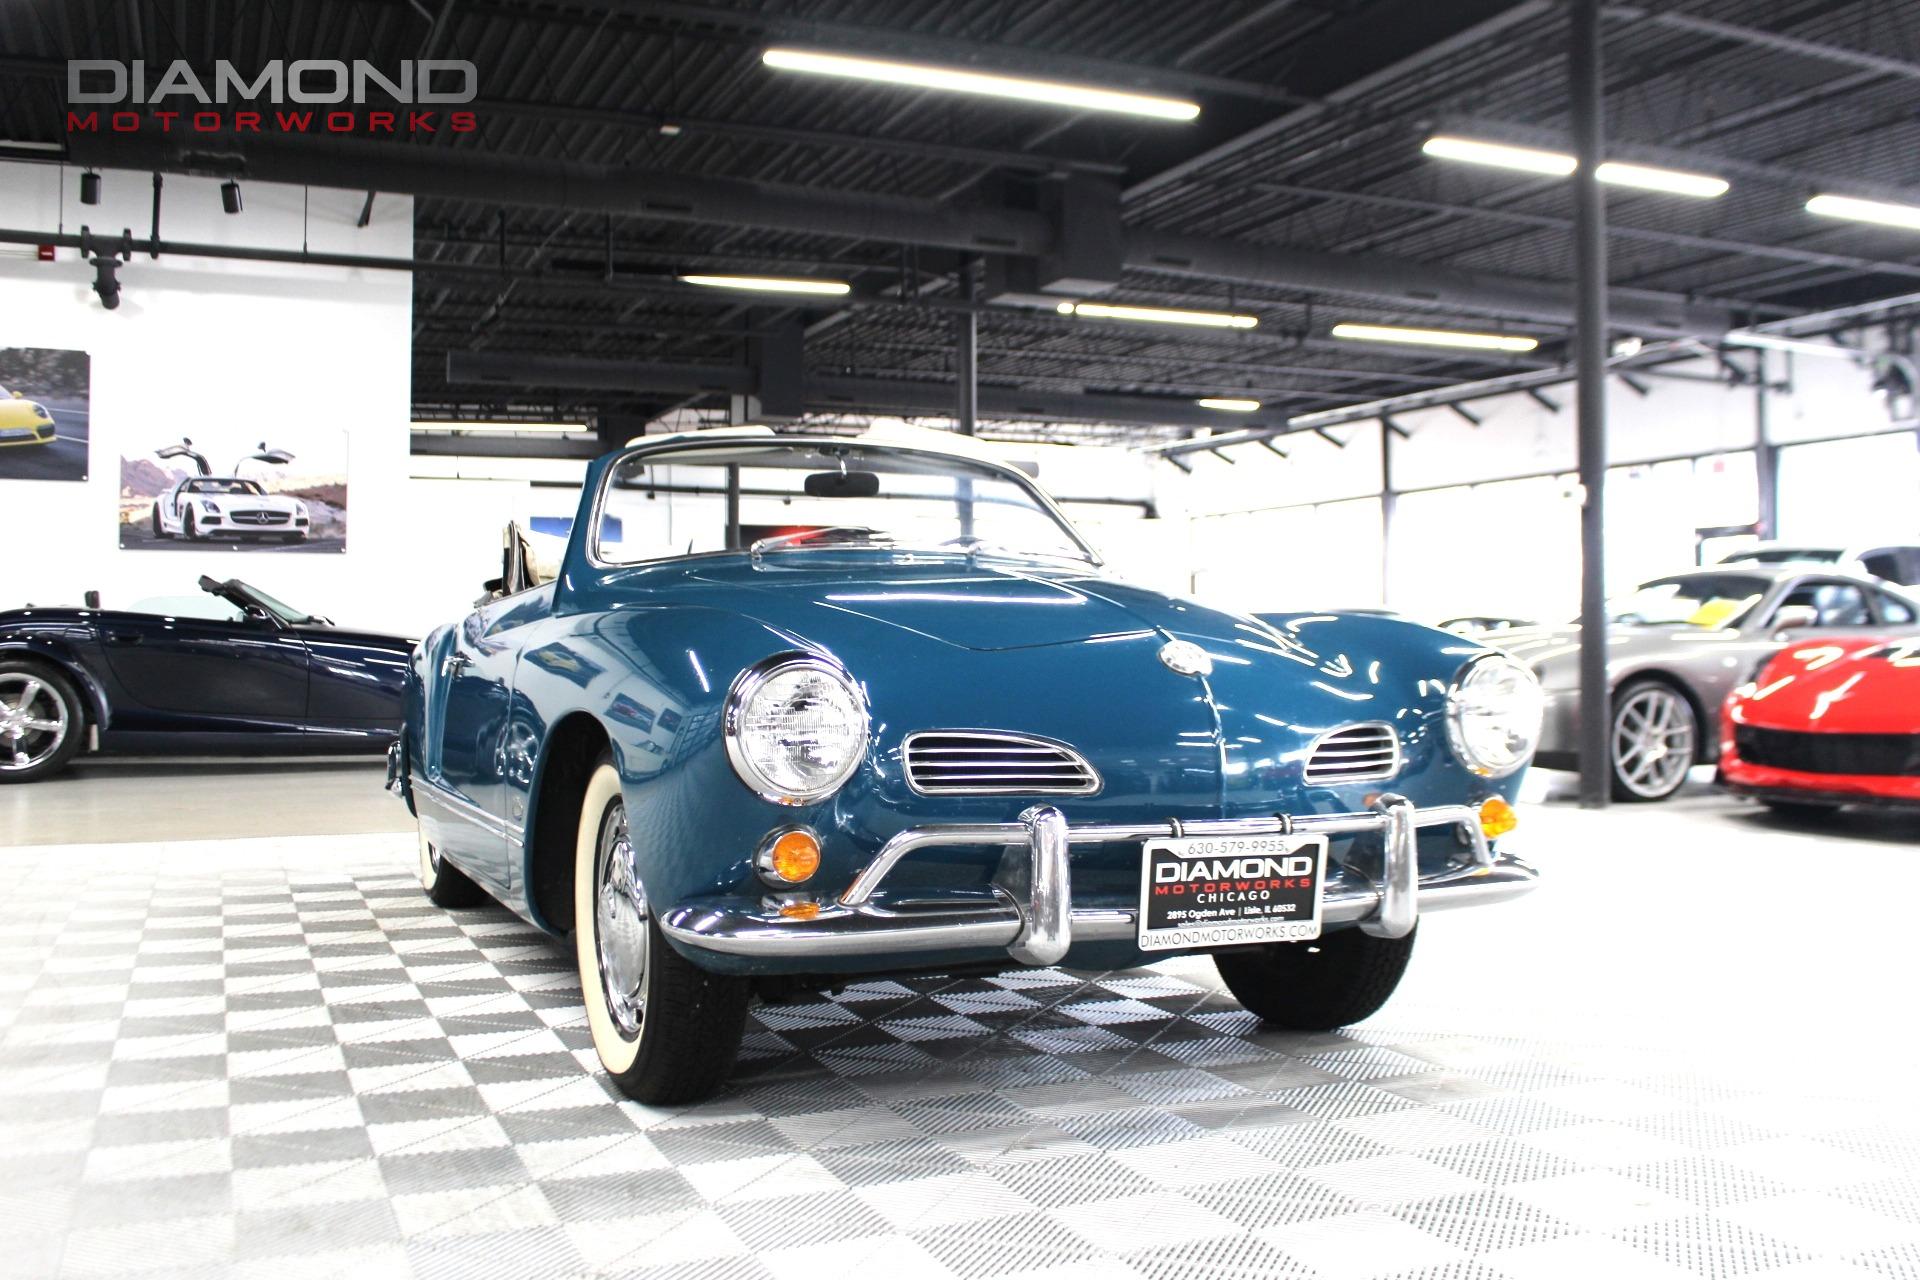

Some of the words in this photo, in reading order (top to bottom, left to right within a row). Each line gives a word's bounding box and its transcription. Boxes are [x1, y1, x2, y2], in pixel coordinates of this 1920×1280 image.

[1188, 840, 1284, 855] 630-579-9955
[1155, 856, 1313, 883] DIAMOND
[1155, 878, 1312, 895] MOTORWORKS
[1196, 890, 1270, 904] CHICAGO
[1166, 910, 1187, 920] 2895
[1188, 908, 1218, 920] Ogden
[1218, 907, 1236, 917] Ave
